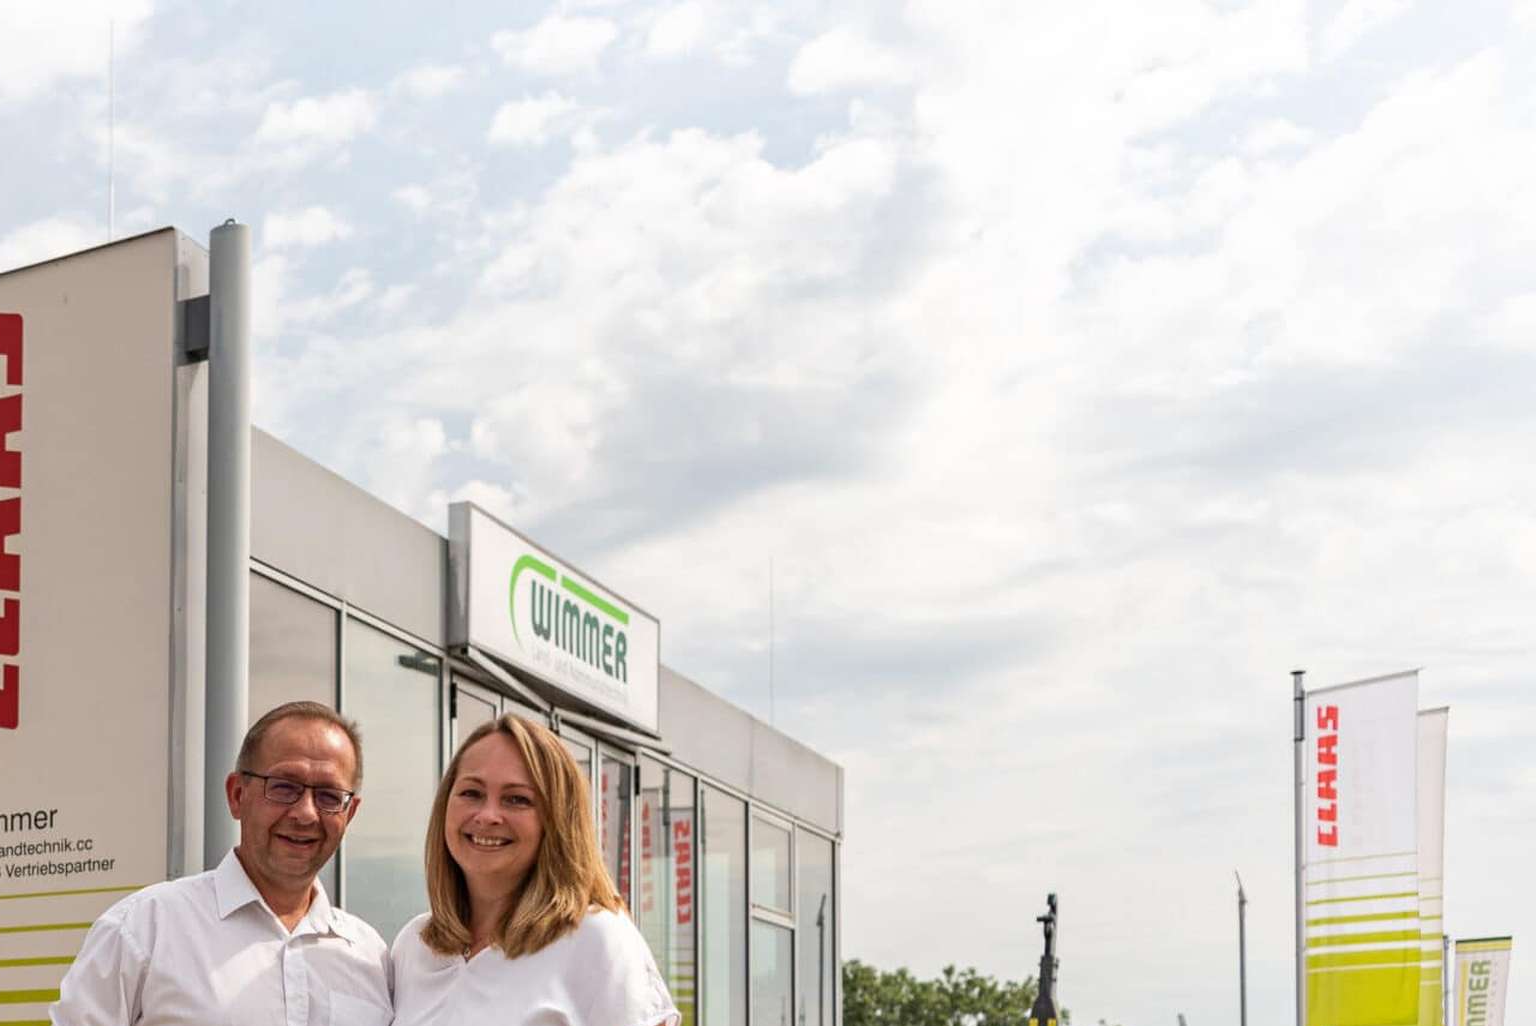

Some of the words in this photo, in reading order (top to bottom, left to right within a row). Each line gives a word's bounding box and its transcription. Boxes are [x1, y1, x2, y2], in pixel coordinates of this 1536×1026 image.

[530, 579, 628, 684] WIMMER
[1317, 705, 1339, 848] CLAAS
[5, 858, 116, 879] Vertriebspartner
